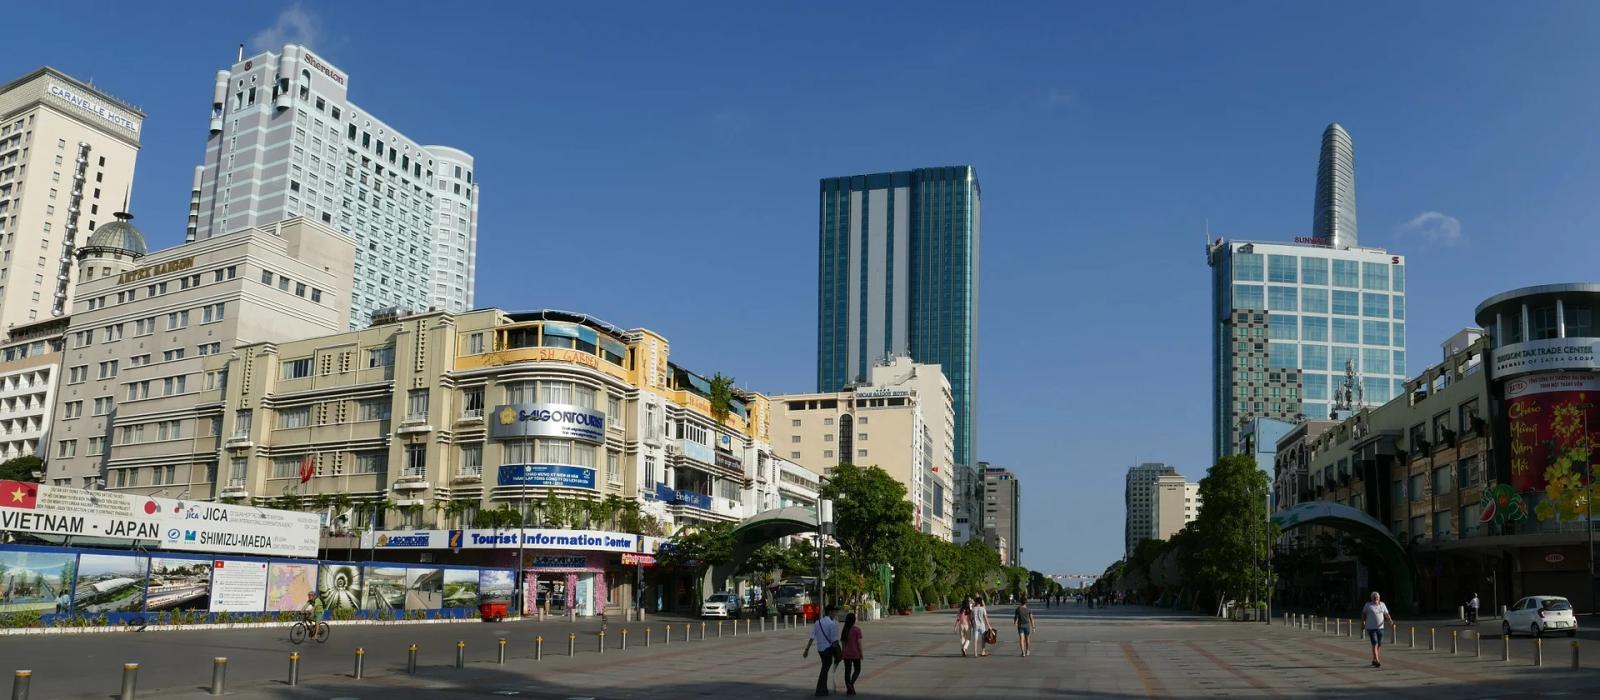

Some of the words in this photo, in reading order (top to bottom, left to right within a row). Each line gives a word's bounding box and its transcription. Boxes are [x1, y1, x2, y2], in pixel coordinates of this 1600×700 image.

[304, 53, 344, 85] Sheraton
[51, 86, 105, 116] CARAVELLE
[108, 113, 136, 131] HOTEL
[540, 349, 555, 359] SH
[563, 350, 599, 367] GARDEN
[1522, 348, 1536, 357] TAX
[1537, 346, 1561, 355] TRADE
[1563, 345, 1593, 353] CENTER
[519, 409, 604, 430] SAIGONTOURIST
[185, 509, 199, 520] JICA
[202, 506, 228, 522] JICA
[1, 511, 84, 533] VIETNAM
[105, 519, 160, 538] JAPAN
[200, 531, 272, 549] SHIMIZU-MAEDA
[472, 533, 518, 544] Tourist
[522, 533, 602, 546] Information
[605, 536, 632, 548] Center
